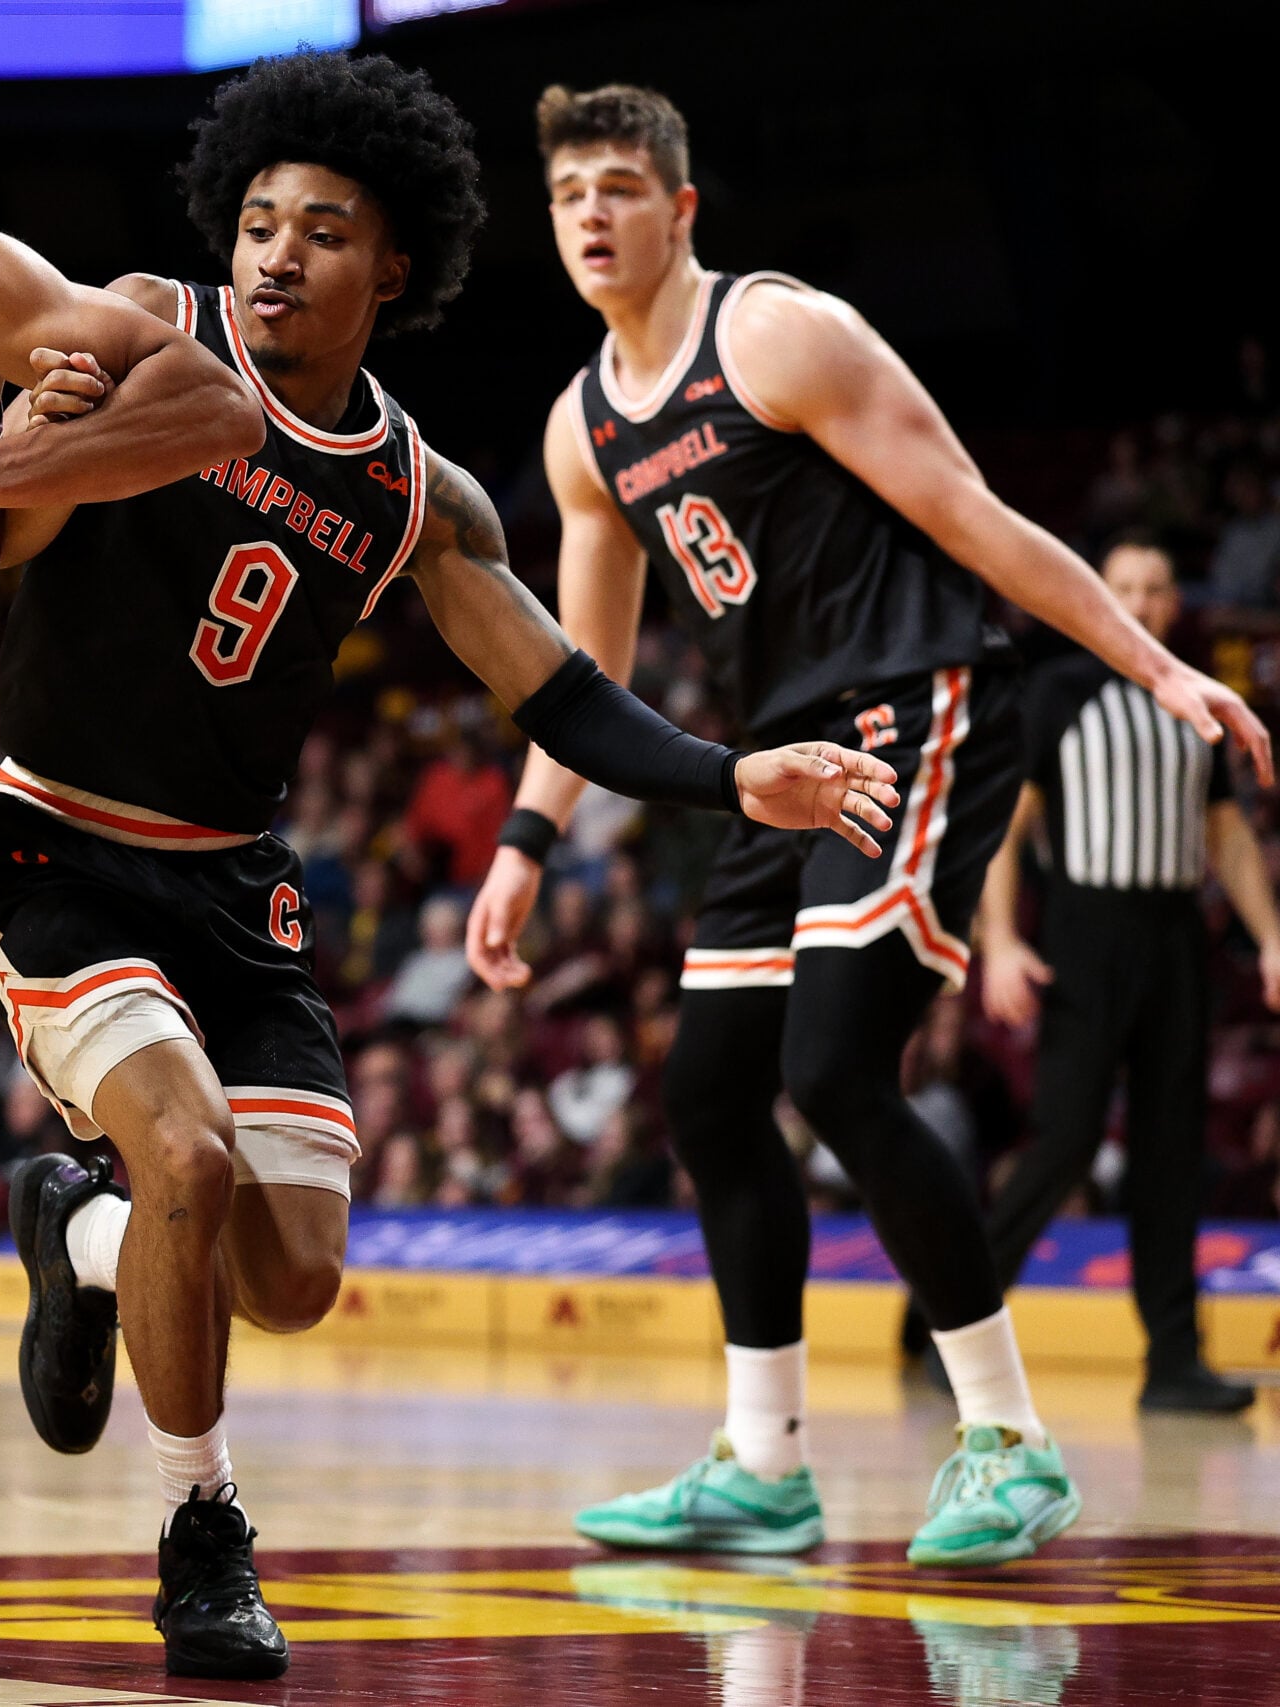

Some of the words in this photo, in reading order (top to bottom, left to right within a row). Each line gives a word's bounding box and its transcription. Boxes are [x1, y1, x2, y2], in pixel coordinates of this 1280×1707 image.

[200, 457, 373, 575] AMPBELL
[655, 493, 758, 620] 13
[188, 541, 300, 687] 9
[269, 883, 303, 952] C
